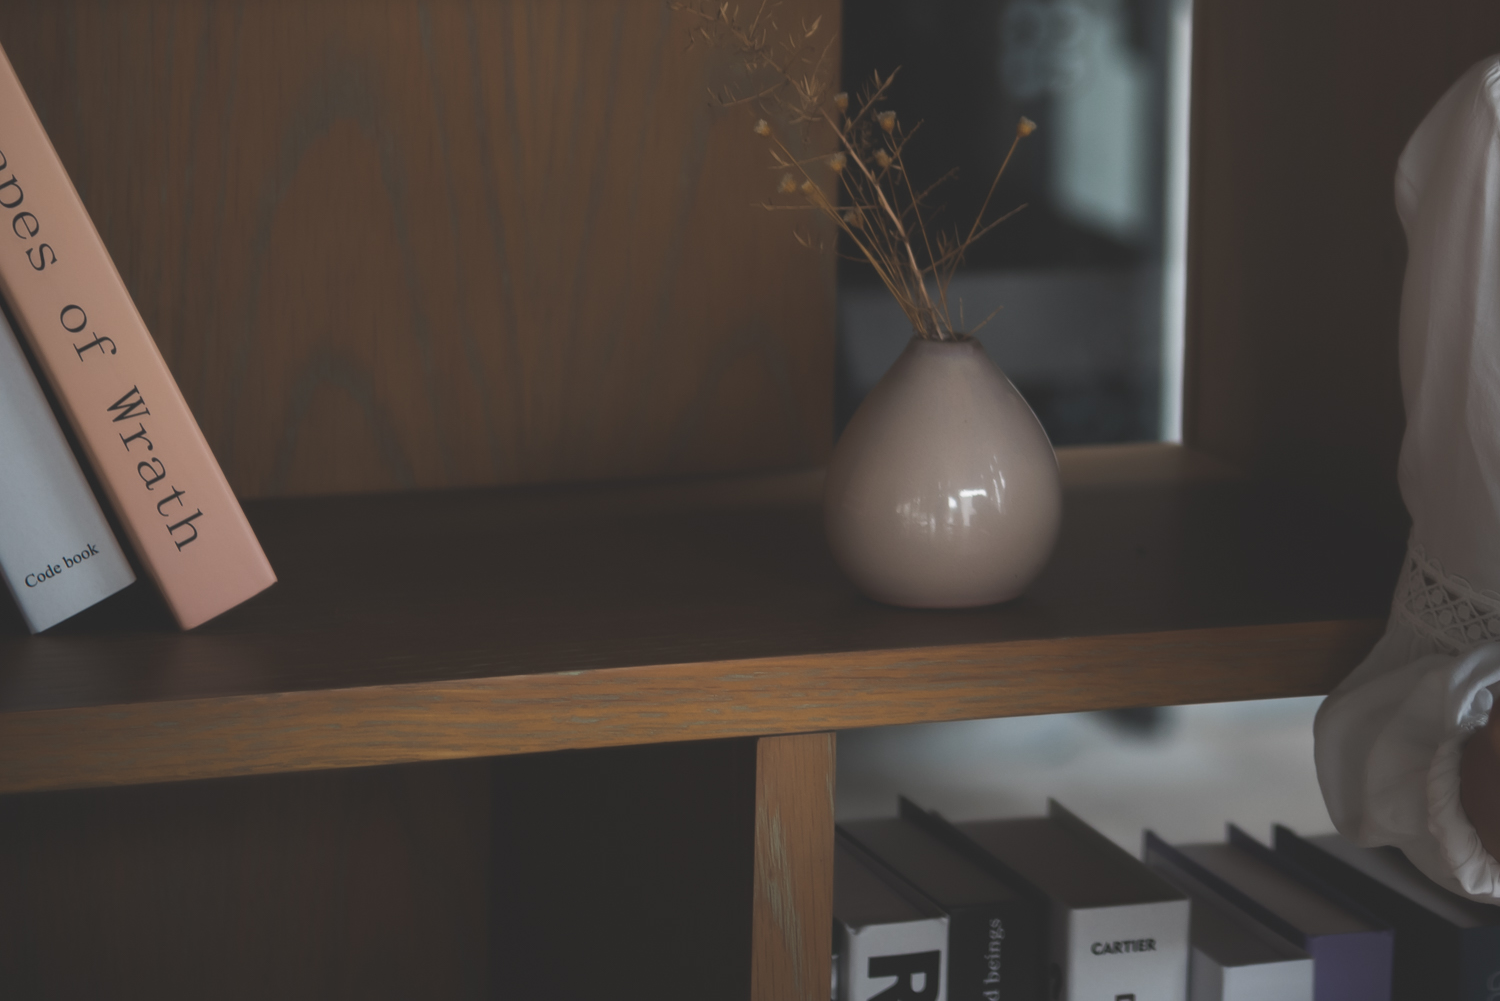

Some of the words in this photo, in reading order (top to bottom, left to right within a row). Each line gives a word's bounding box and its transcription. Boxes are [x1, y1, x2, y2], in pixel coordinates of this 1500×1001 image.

[0, 150, 57, 271] pes
[60, 304, 117, 362] of
[107, 385, 203, 552] Wrath
[24, 564, 62, 588] Code
[62, 544, 99, 568] book
[982, 918, 1006, 985] beings
[1090, 938, 1157, 956] CARTIER
